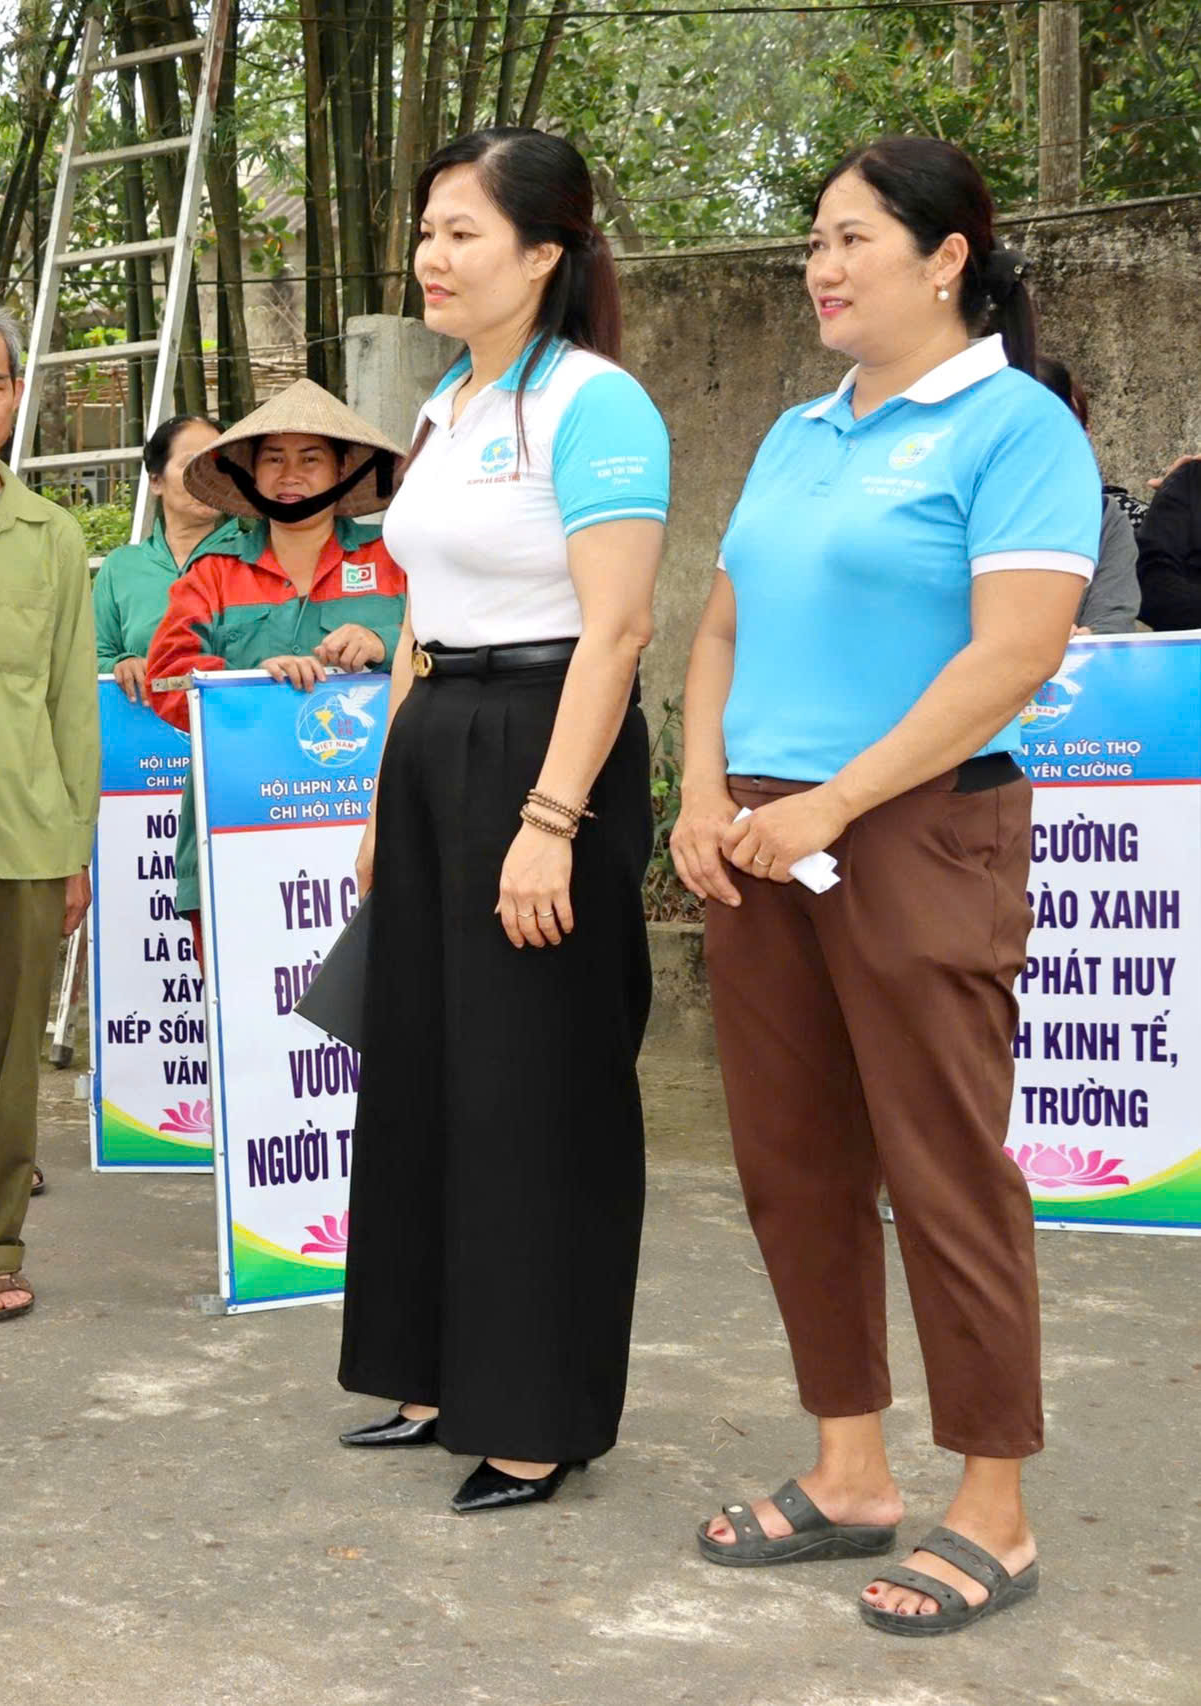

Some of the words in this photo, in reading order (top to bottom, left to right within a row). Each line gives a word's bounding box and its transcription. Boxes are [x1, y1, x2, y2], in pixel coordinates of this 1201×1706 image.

[140, 754, 163, 772] HỘI
[167, 757, 190, 769] LHP
[1034, 740, 1058, 756] XÃ
[1064, 738, 1101, 756] ĐỨC
[1106, 741, 1141, 758] THỌ
[146, 776, 169, 787] CHI
[1031, 762, 1062, 777] YÊN
[1067, 761, 1133, 777] CƯỜNG
[261, 779, 288, 800] HỘI
[293, 780, 331, 795] LHPN
[336, 775, 358, 792] XÃ
[270, 805, 297, 820] CHI
[302, 800, 329, 821] HỘI
[334, 799, 362, 816] YÊN
[1030, 813, 1138, 863] CƯỜNG
[150, 889, 180, 921] ỨN
[279, 869, 332, 930] YÊN
[1090, 890, 1180, 929] XANH
[144, 932, 170, 962] LÀ
[1020, 948, 1101, 995] PHÁT
[1113, 957, 1176, 996] HUY
[162, 973, 205, 1003] XÂY
[107, 1010, 151, 1044] NẾP
[159, 1010, 205, 1044] SỐN
[1044, 1022, 1120, 1061] KINH
[1131, 1010, 1178, 1067] TẾ,
[163, 1055, 207, 1085] VĂN
[1021, 1078, 1148, 1128] TRƯỜNG
[247, 1120, 329, 1188] NGƯỜI
